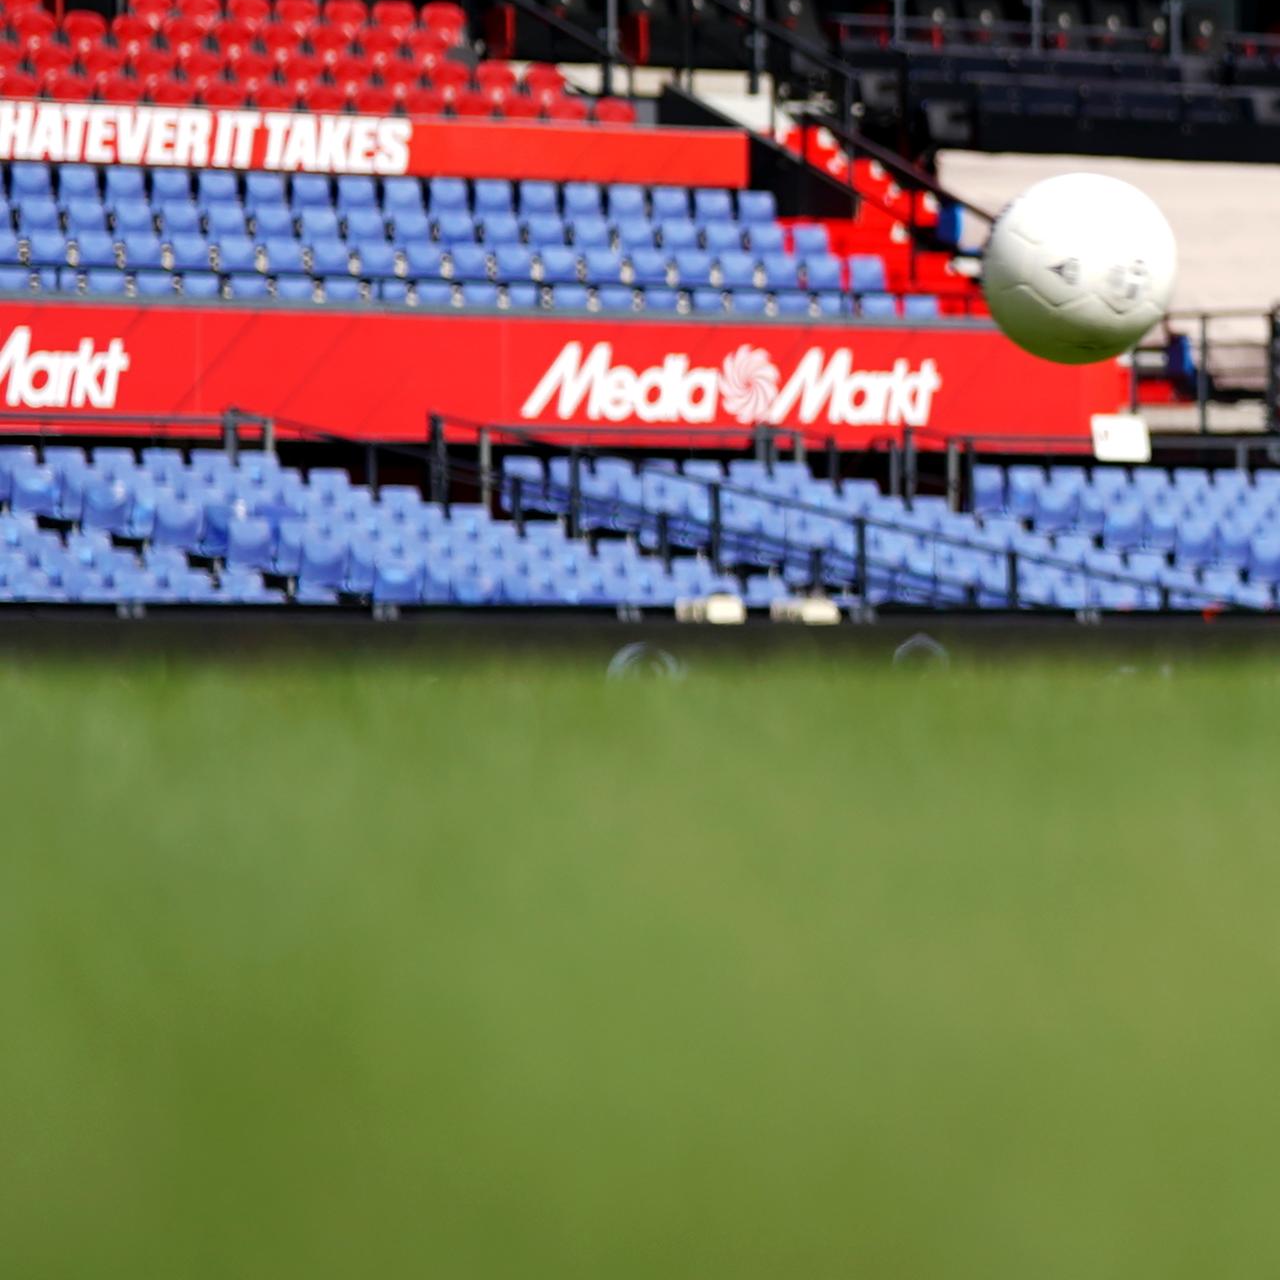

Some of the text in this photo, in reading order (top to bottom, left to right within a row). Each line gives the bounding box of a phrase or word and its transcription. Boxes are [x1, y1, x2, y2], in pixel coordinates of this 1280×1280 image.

[0, 100, 413, 176] HATEVER IT TAKES
